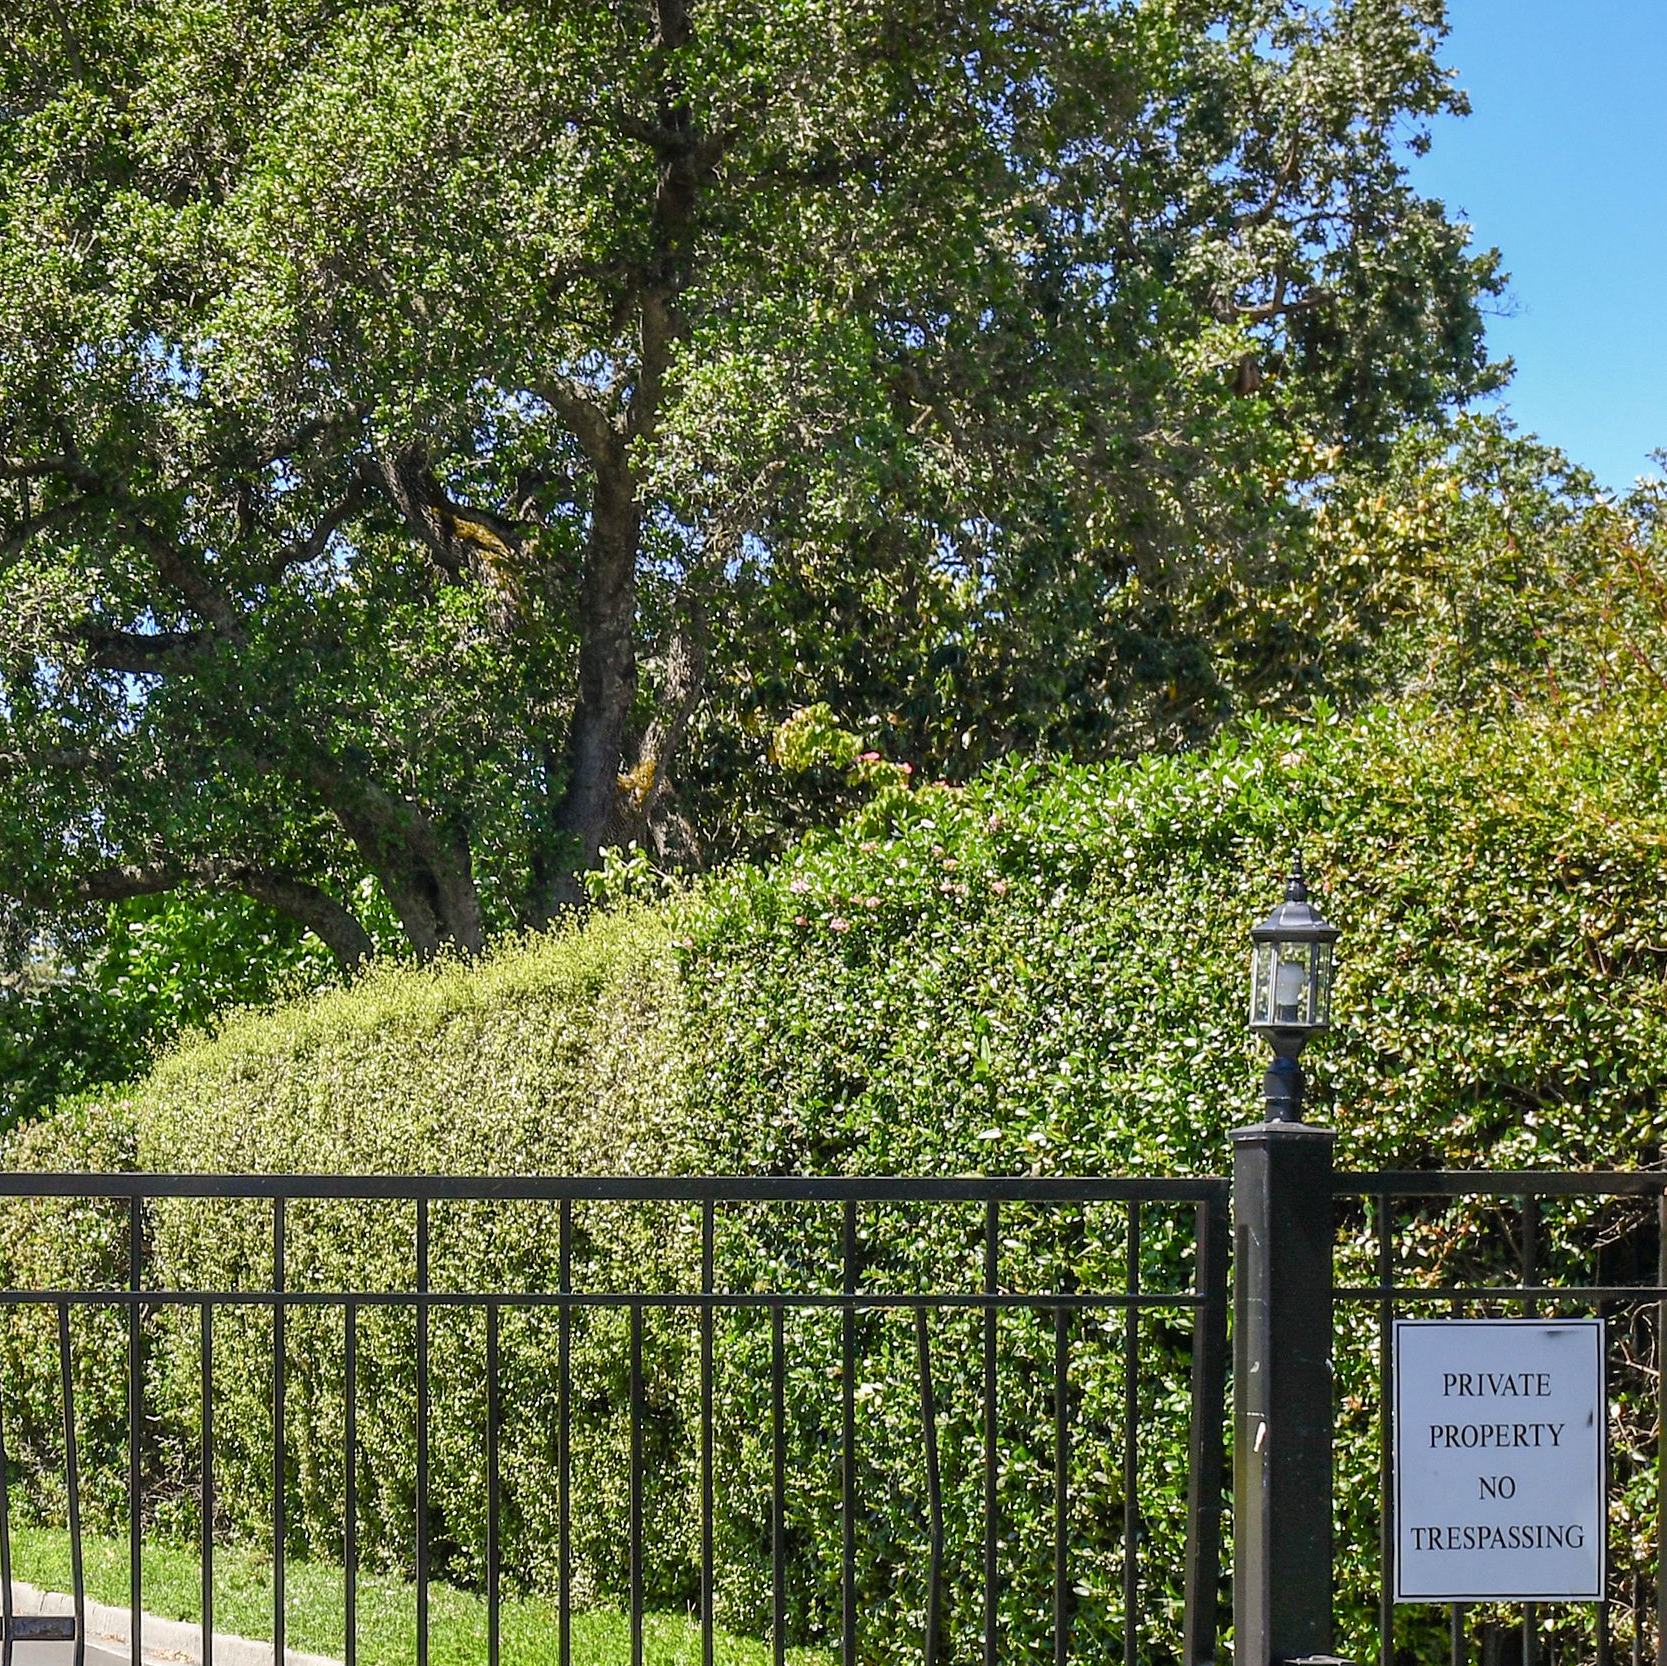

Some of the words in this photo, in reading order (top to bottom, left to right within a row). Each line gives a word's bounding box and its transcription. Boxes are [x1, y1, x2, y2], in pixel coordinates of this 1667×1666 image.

[1442, 1372, 1552, 1397] PRIVATE
[1429, 1423, 1565, 1449] PROPERTY
[1478, 1475, 1516, 1500] NO
[1410, 1524, 1585, 1550] TRESPASSING
